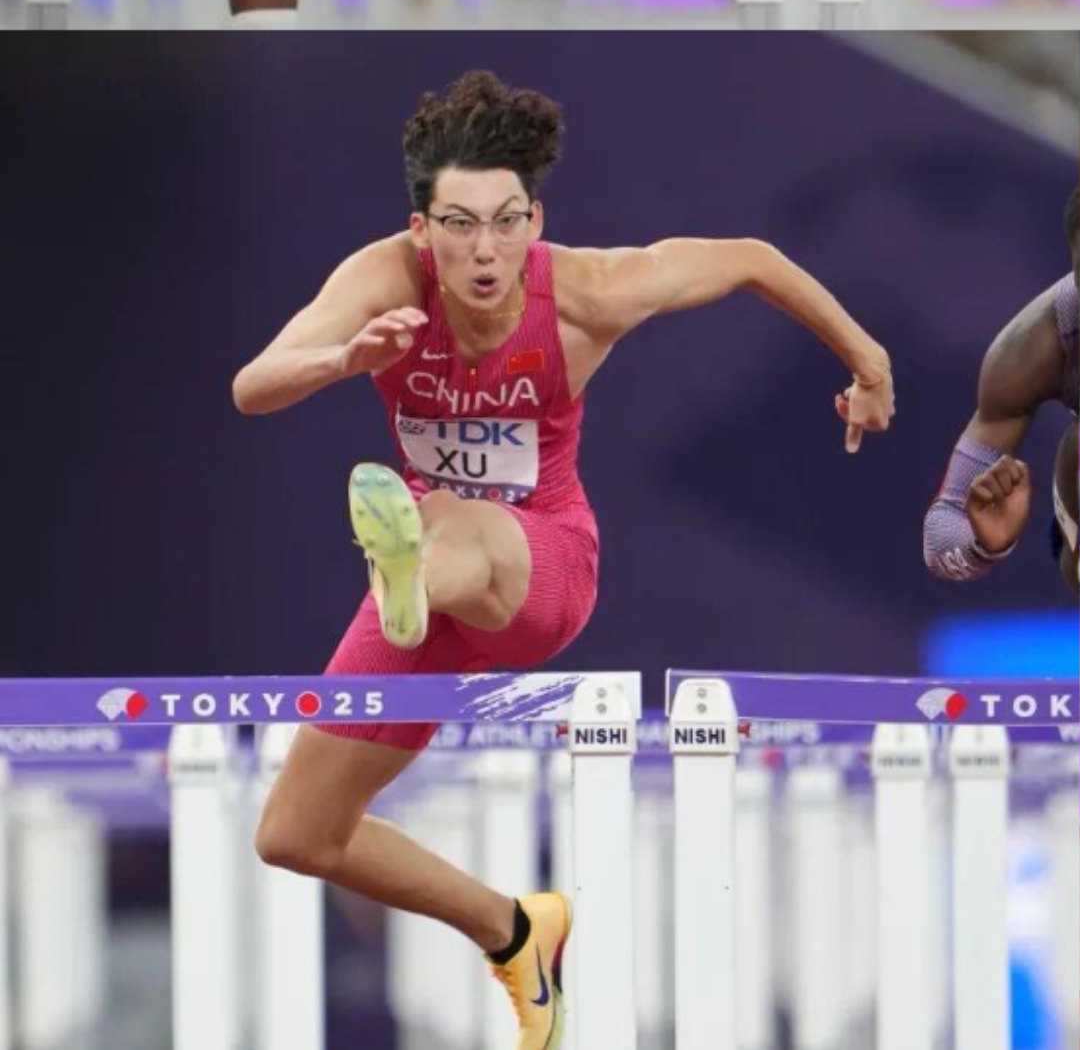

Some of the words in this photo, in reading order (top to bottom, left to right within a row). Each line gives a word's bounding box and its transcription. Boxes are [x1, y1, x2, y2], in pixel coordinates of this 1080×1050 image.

[407, 371, 540, 414] CHINA
[425, 421, 524, 446] TDK
[435, 446, 487, 479] XU
[575, 728, 628, 745] NISHI
[674, 728, 726, 745] NISHI
